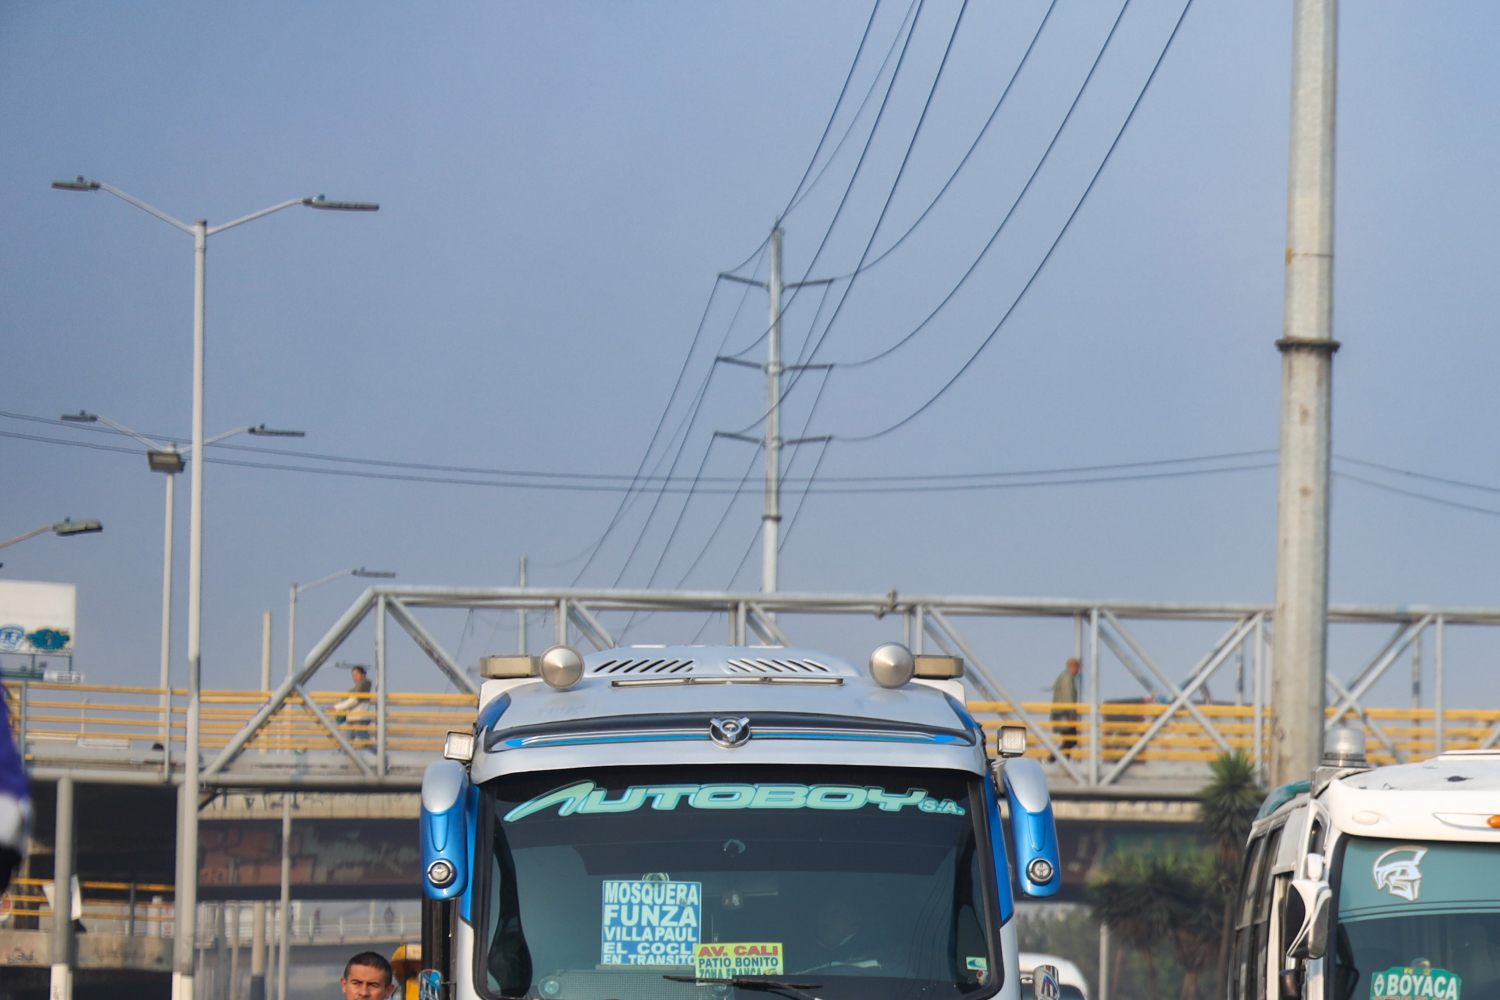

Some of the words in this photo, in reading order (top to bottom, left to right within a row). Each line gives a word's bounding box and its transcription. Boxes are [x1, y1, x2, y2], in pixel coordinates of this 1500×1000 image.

[503, 781, 928, 822] AUTOBOY
[605, 882, 698, 906] MOSQUERA
[604, 904, 698, 928] FUNZA
[603, 942, 628, 954] EL
[698, 946, 728, 957] AV.
[734, 945, 778, 956] CALI
[603, 954, 622, 965] EN
[628, 954, 695, 965] TRANSITO
[699, 957, 731, 968] PATIO
[735, 957, 778, 967] BONITO
[1387, 974, 1457, 1000] BOYACA
